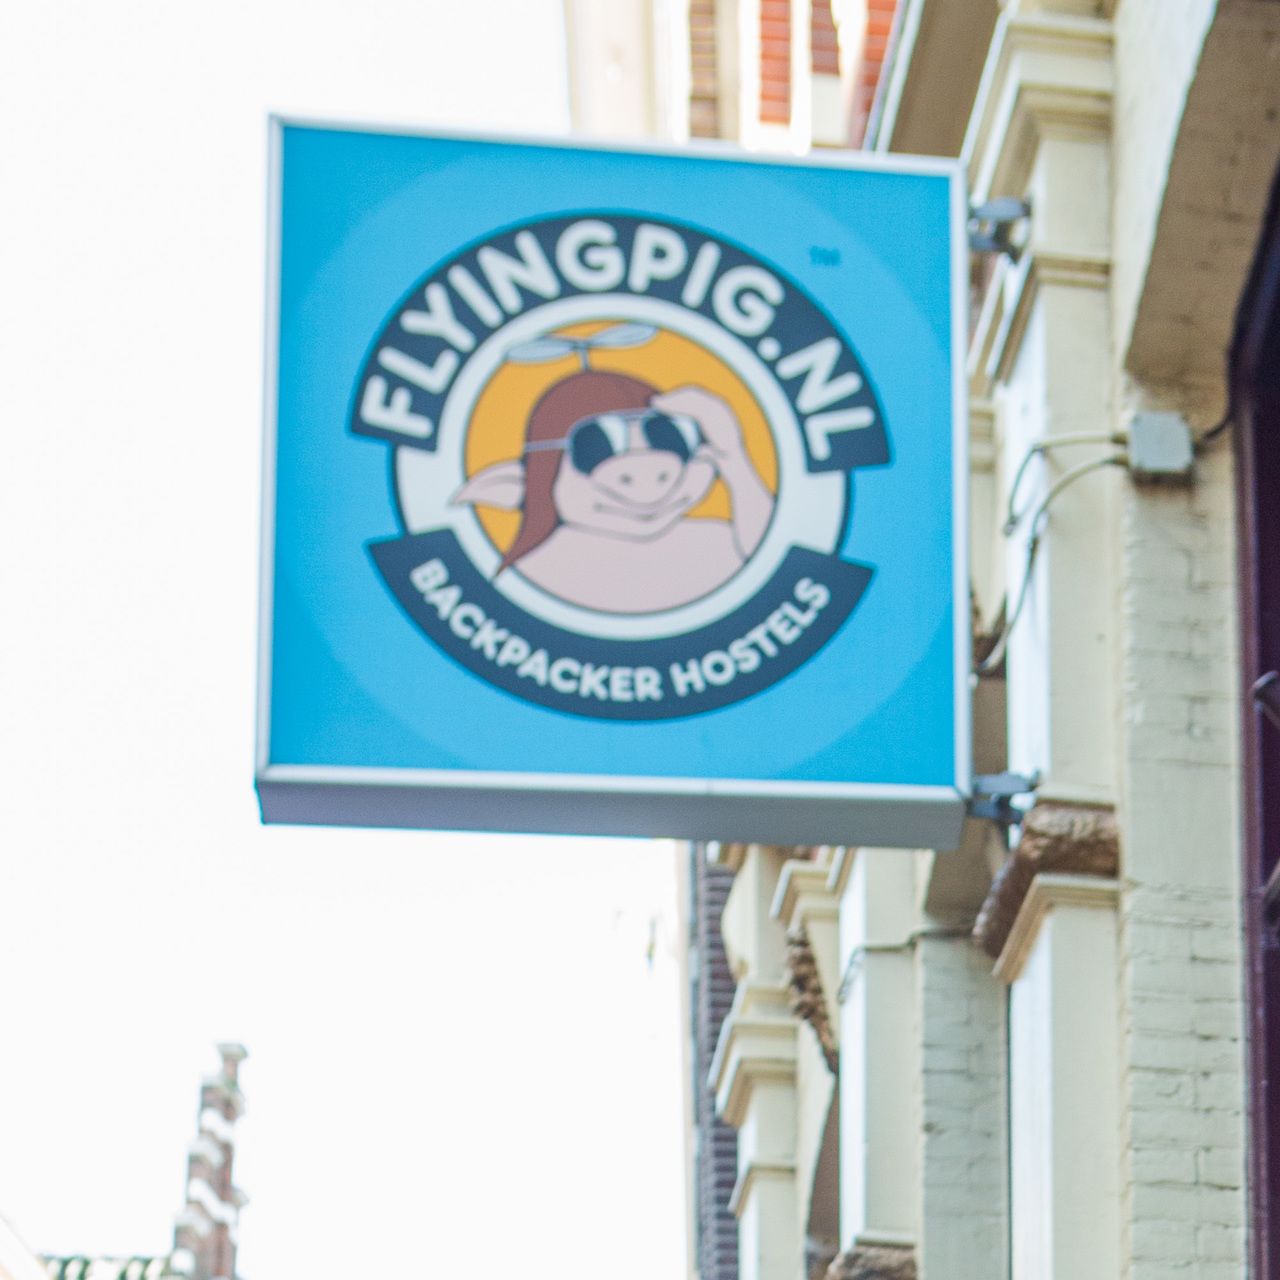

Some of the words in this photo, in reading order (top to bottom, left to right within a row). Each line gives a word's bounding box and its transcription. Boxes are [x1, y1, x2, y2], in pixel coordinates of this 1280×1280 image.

[360, 220, 874, 461] FLYINGPIG.NL
[411, 559, 663, 702] BACKPACKER
[671, 577, 831, 696] HOSTELS
